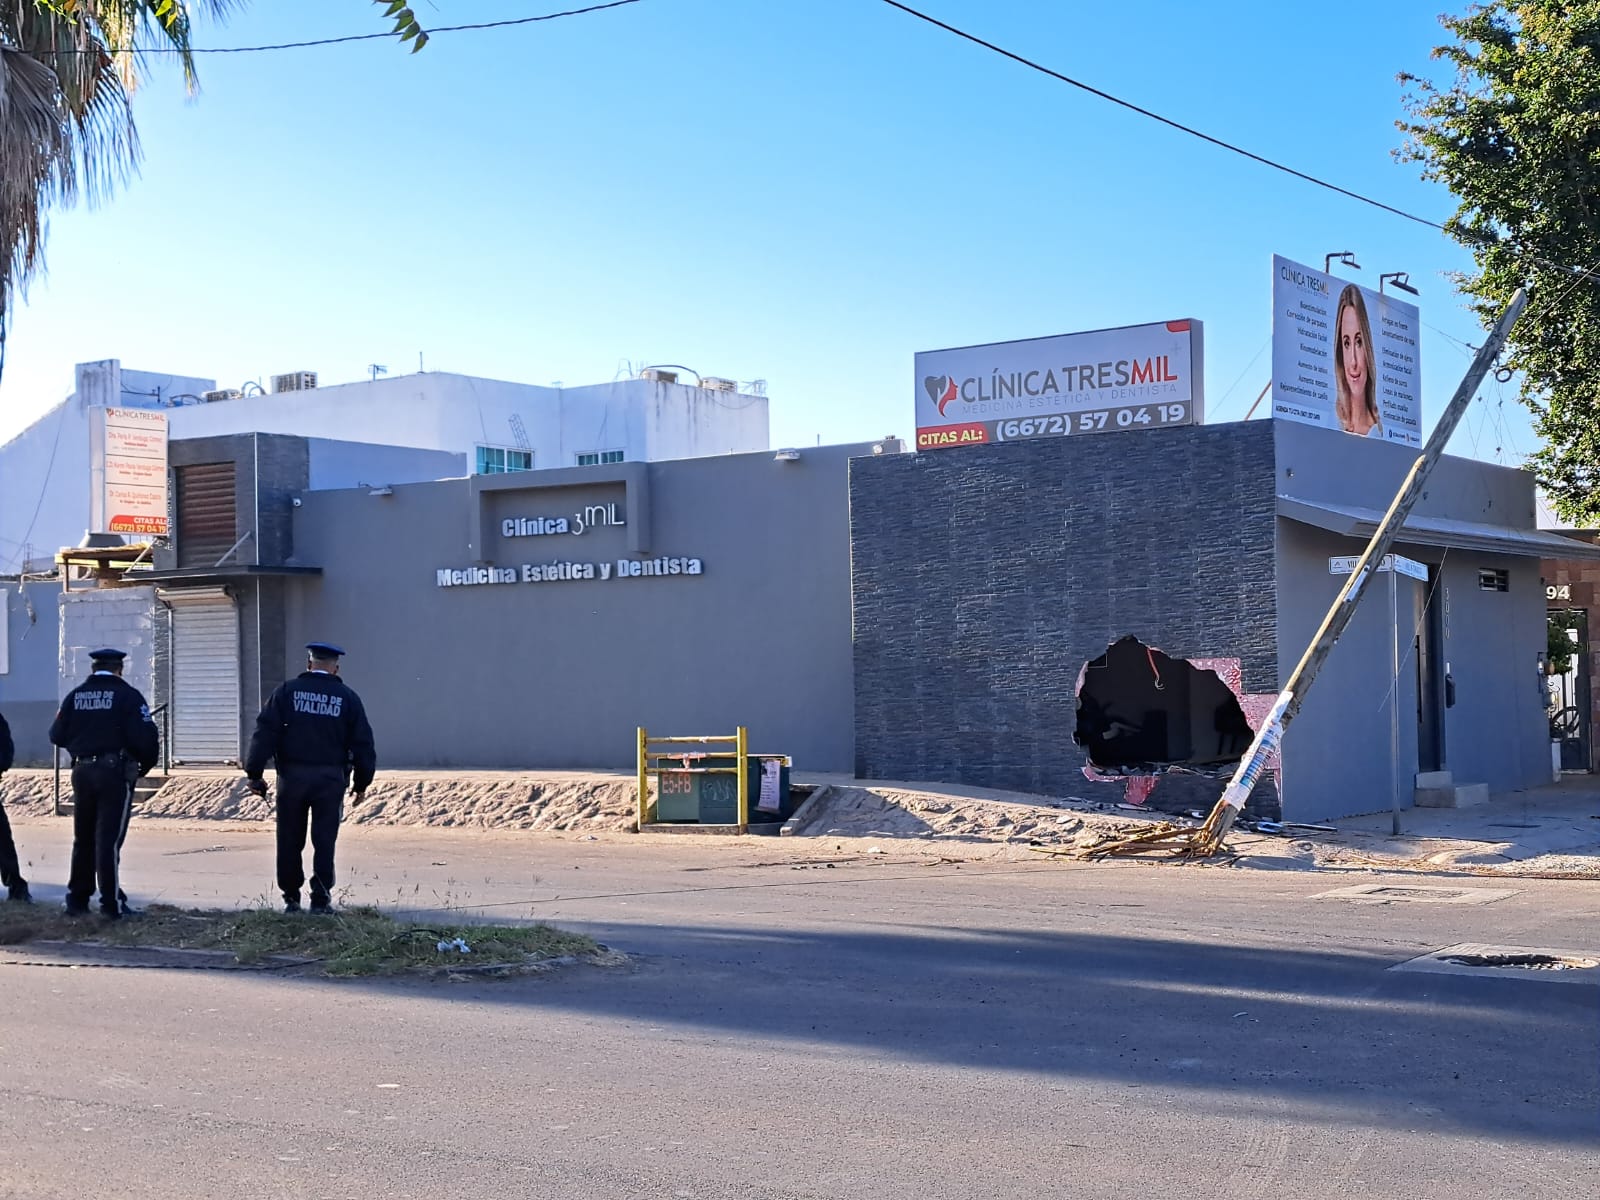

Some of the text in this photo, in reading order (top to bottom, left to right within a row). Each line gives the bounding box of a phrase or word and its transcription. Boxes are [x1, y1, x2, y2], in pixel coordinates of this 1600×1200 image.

[1281, 266, 1306, 287] CLÍNICA
[962, 400, 1023, 415] MEDICINA
[1099, 391, 1105, 401] Y
[1112, 383, 1177, 400] DENTISTA
[919, 404, 1186, 446] CITAS AL: (6672) 57 04 19
[112, 522, 135, 533] (6672)
[136, 524, 146, 532] 57
[146, 525, 157, 533] 04
[502, 517, 568, 537] Clínica
[437, 556, 702, 587] Medicina Estética y Dentista
[1546, 584, 1570, 600] 94
[74, 691, 114, 700] UNIDAD DE
[293, 690, 343, 706] UNIDAD DE
[74, 699, 113, 710] VIALIDAD
[293, 700, 341, 717] VIALIDAD
